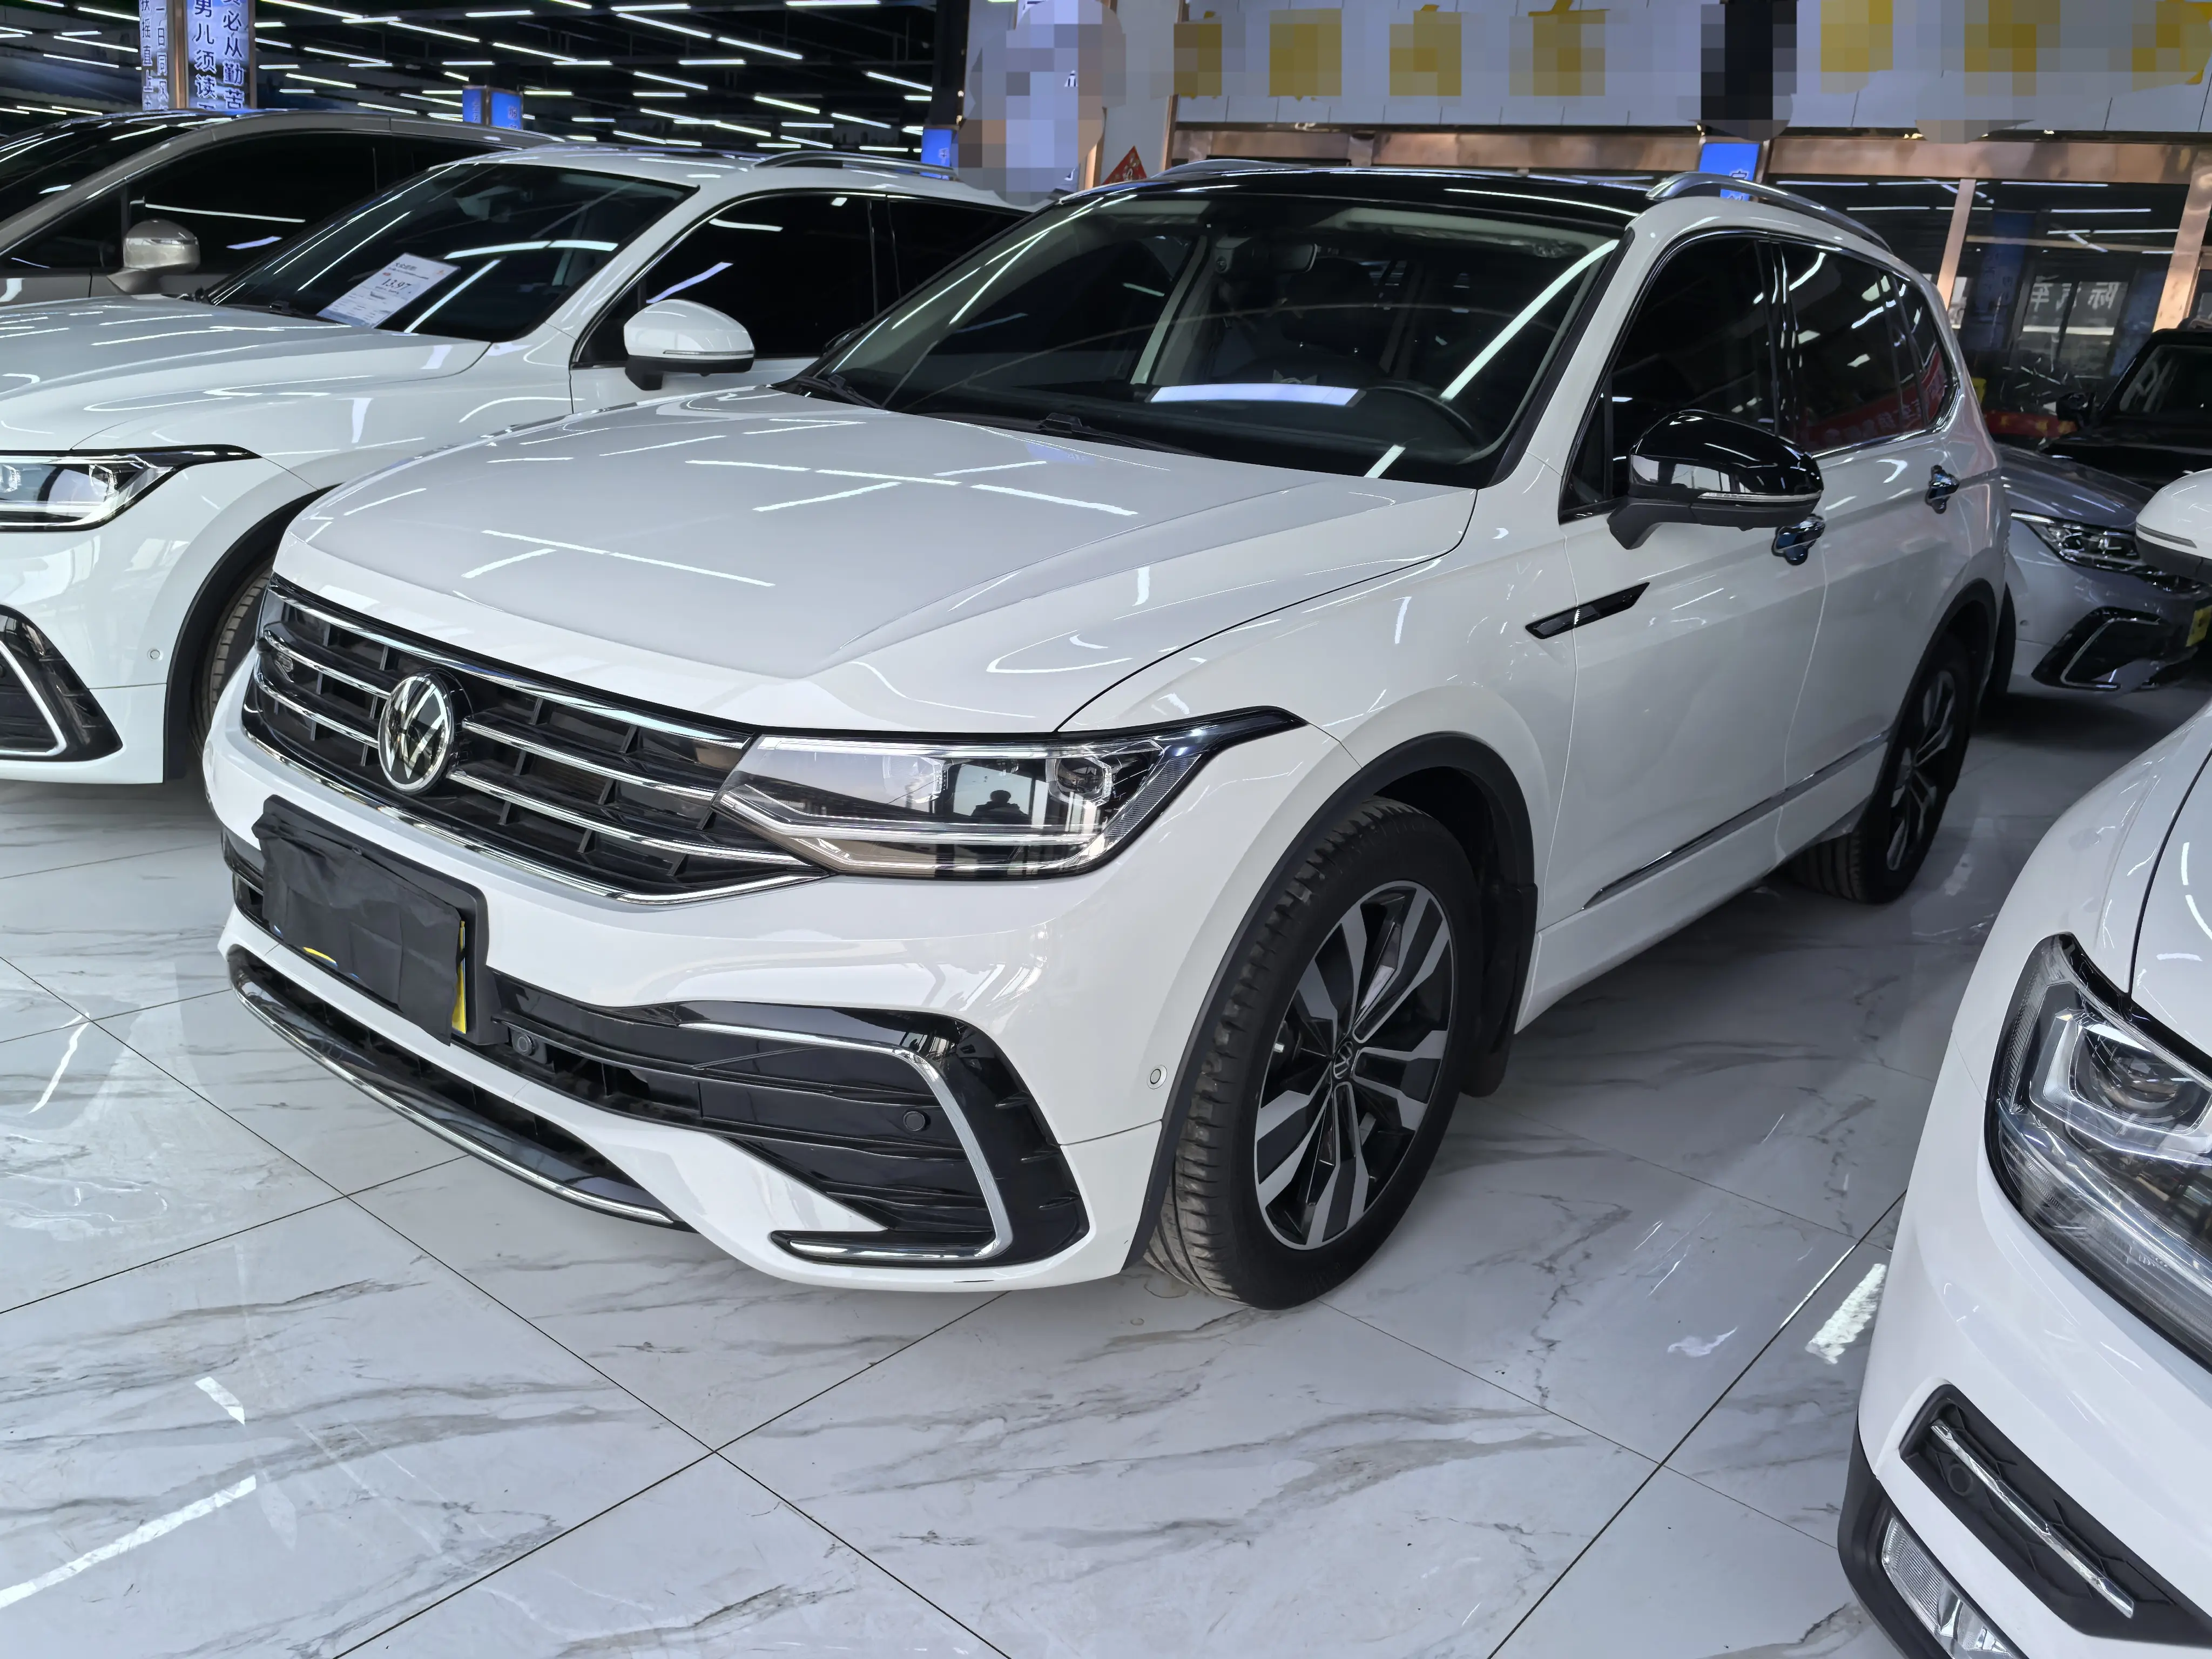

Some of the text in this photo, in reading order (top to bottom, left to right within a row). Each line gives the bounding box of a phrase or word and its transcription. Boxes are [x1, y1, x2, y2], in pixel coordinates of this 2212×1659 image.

[156, 8, 168, 110] 一日同风
[193, 0, 217, 109] 男儿须读
[223, 0, 244, 109] 必从勤苦
